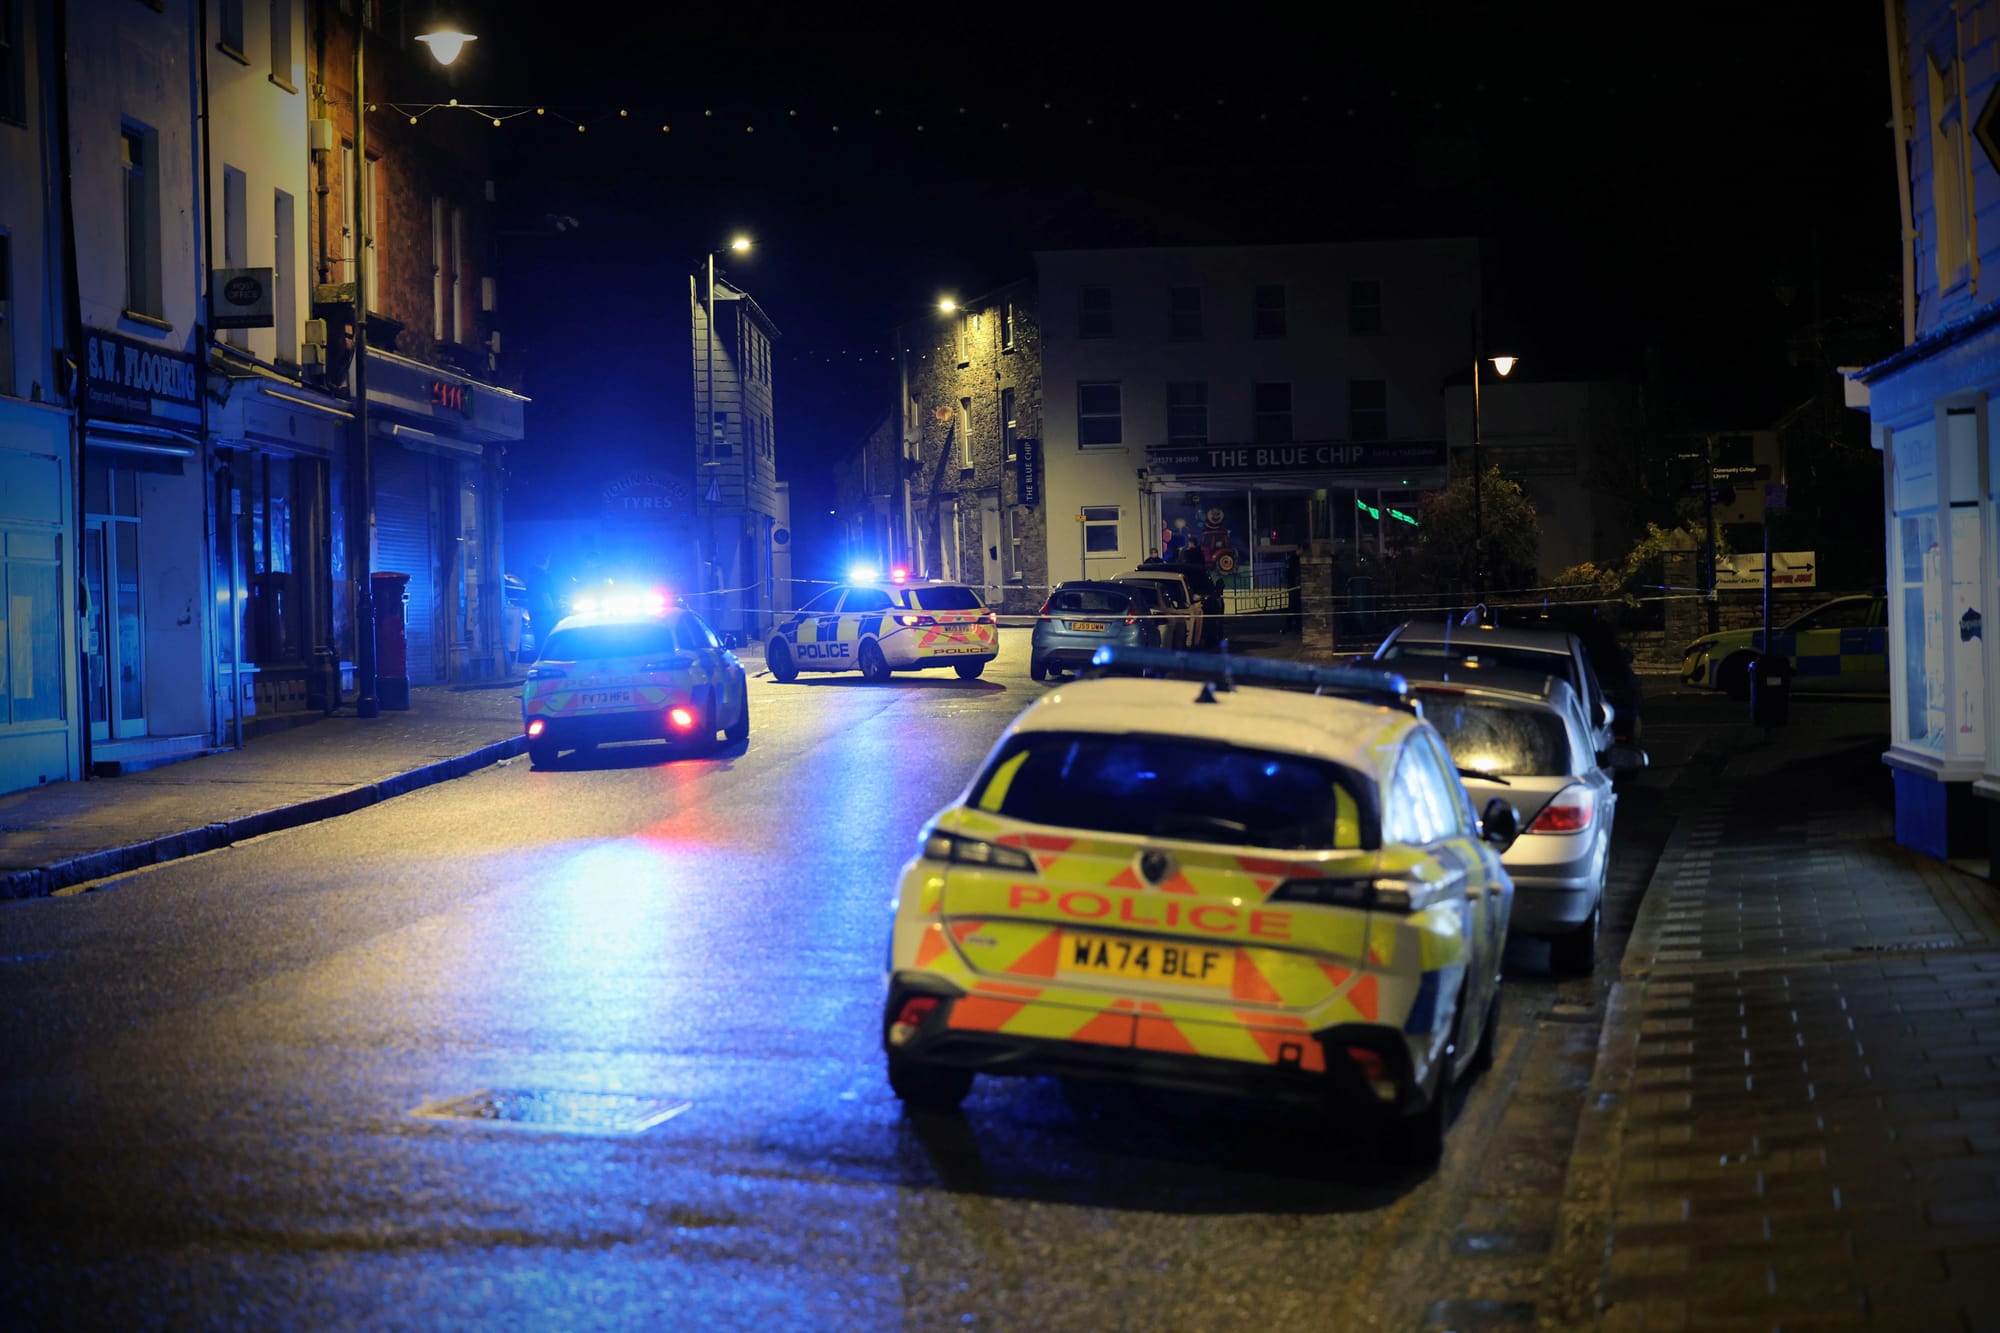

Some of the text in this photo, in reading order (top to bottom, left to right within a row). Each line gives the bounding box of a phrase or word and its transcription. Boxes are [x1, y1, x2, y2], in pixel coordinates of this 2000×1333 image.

[122, 345, 197, 401] FLOORING
[1207, 449, 1249, 468] THE
[1256, 447, 1309, 466] BLUE
[1316, 445, 1364, 465] CHIP
[1023, 441, 1033, 501] THE BLUE CHIP
[1712, 466, 1739, 474] Community
[623, 495, 673, 511] TYRES
[797, 642, 850, 660] POLICE
[933, 647, 989, 655] POLICE
[1008, 884, 1294, 940] POLICE
[1073, 936, 1221, 980] WA74 BLF
